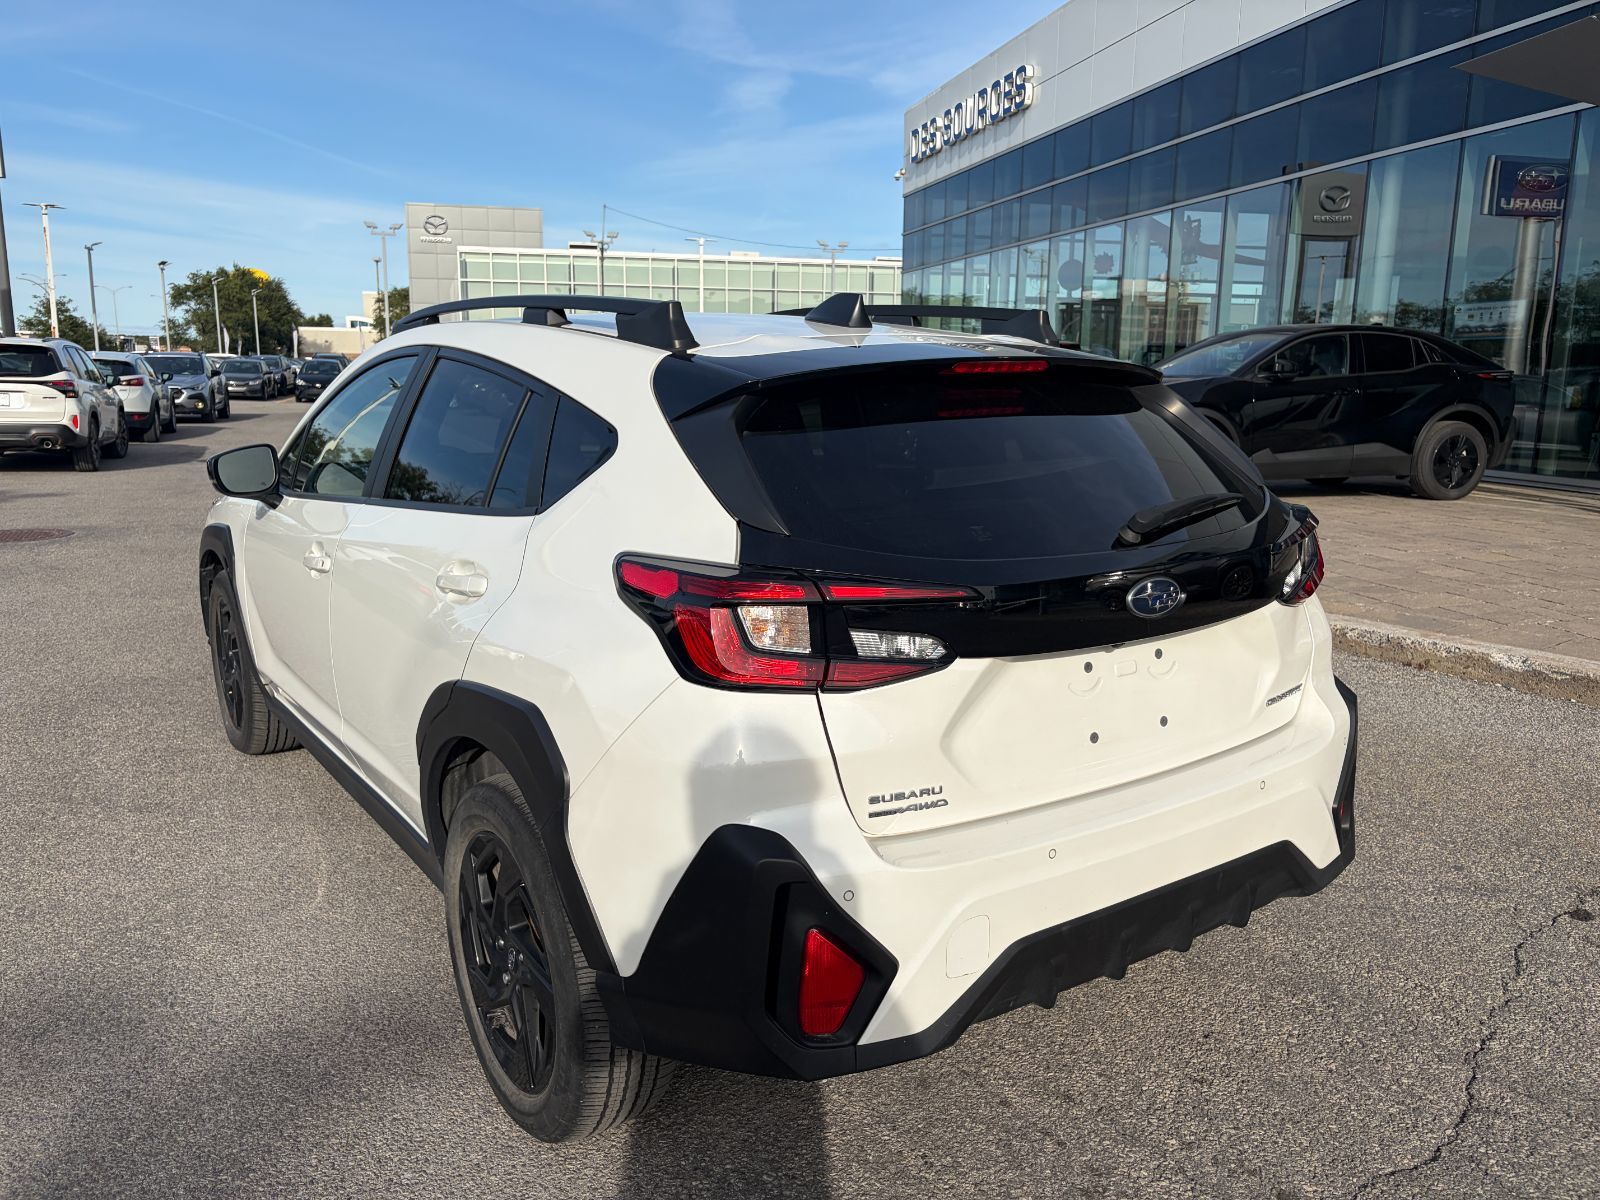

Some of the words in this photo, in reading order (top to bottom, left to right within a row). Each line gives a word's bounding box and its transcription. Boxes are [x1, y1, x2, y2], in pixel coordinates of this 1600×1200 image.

[909, 117, 943, 163] DES
[942, 65, 1034, 146] SOURCES
[868, 785, 943, 804] SUBARU
[903, 798, 949, 813] AWD
